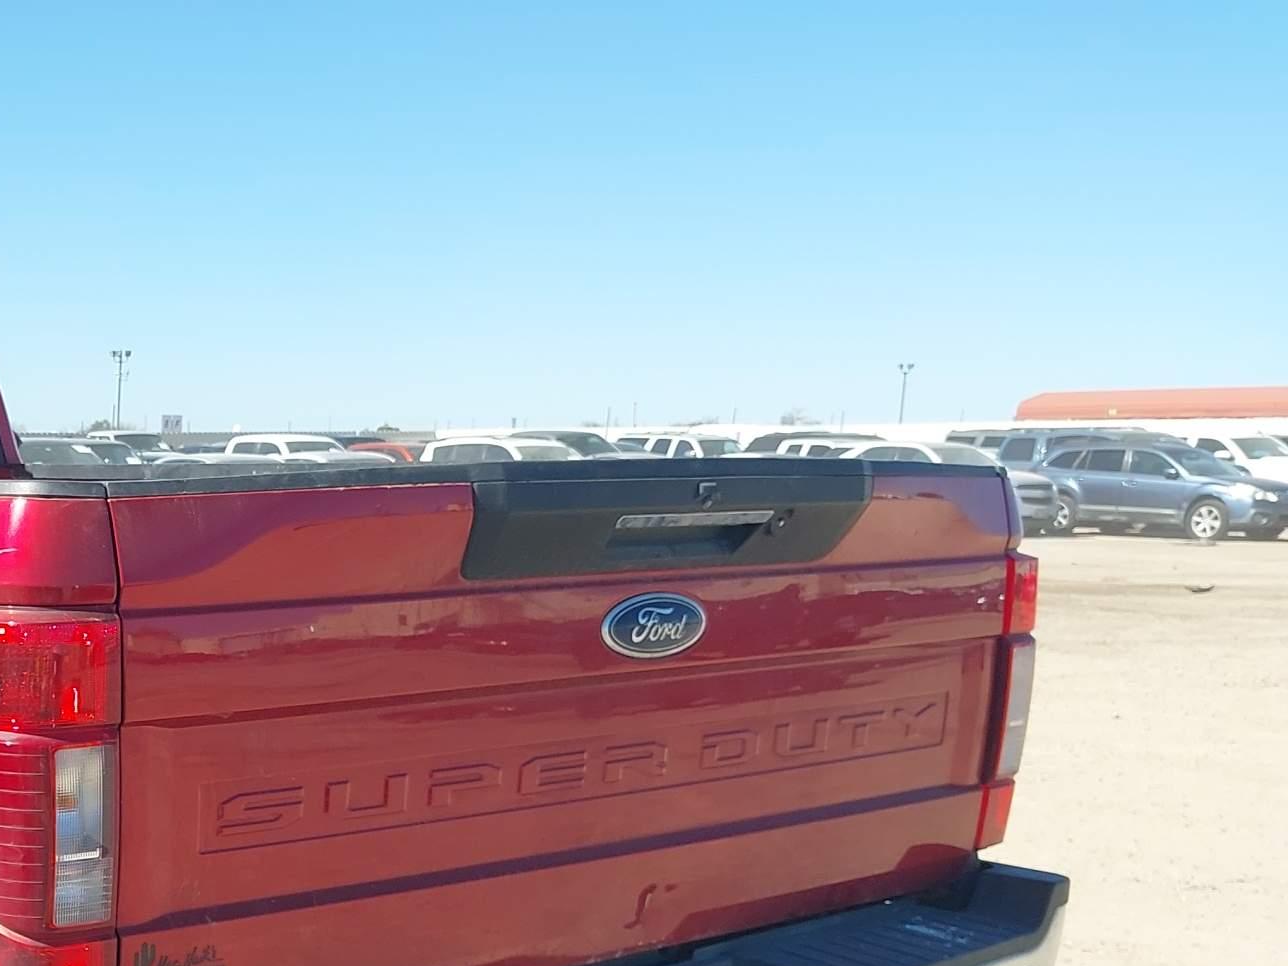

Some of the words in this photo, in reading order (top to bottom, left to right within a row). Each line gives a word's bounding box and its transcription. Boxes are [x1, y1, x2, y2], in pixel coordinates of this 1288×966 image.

[631, 606, 687, 643] Ford
[215, 740, 668, 837] SUPER
[700, 702, 939, 770] DUTY
